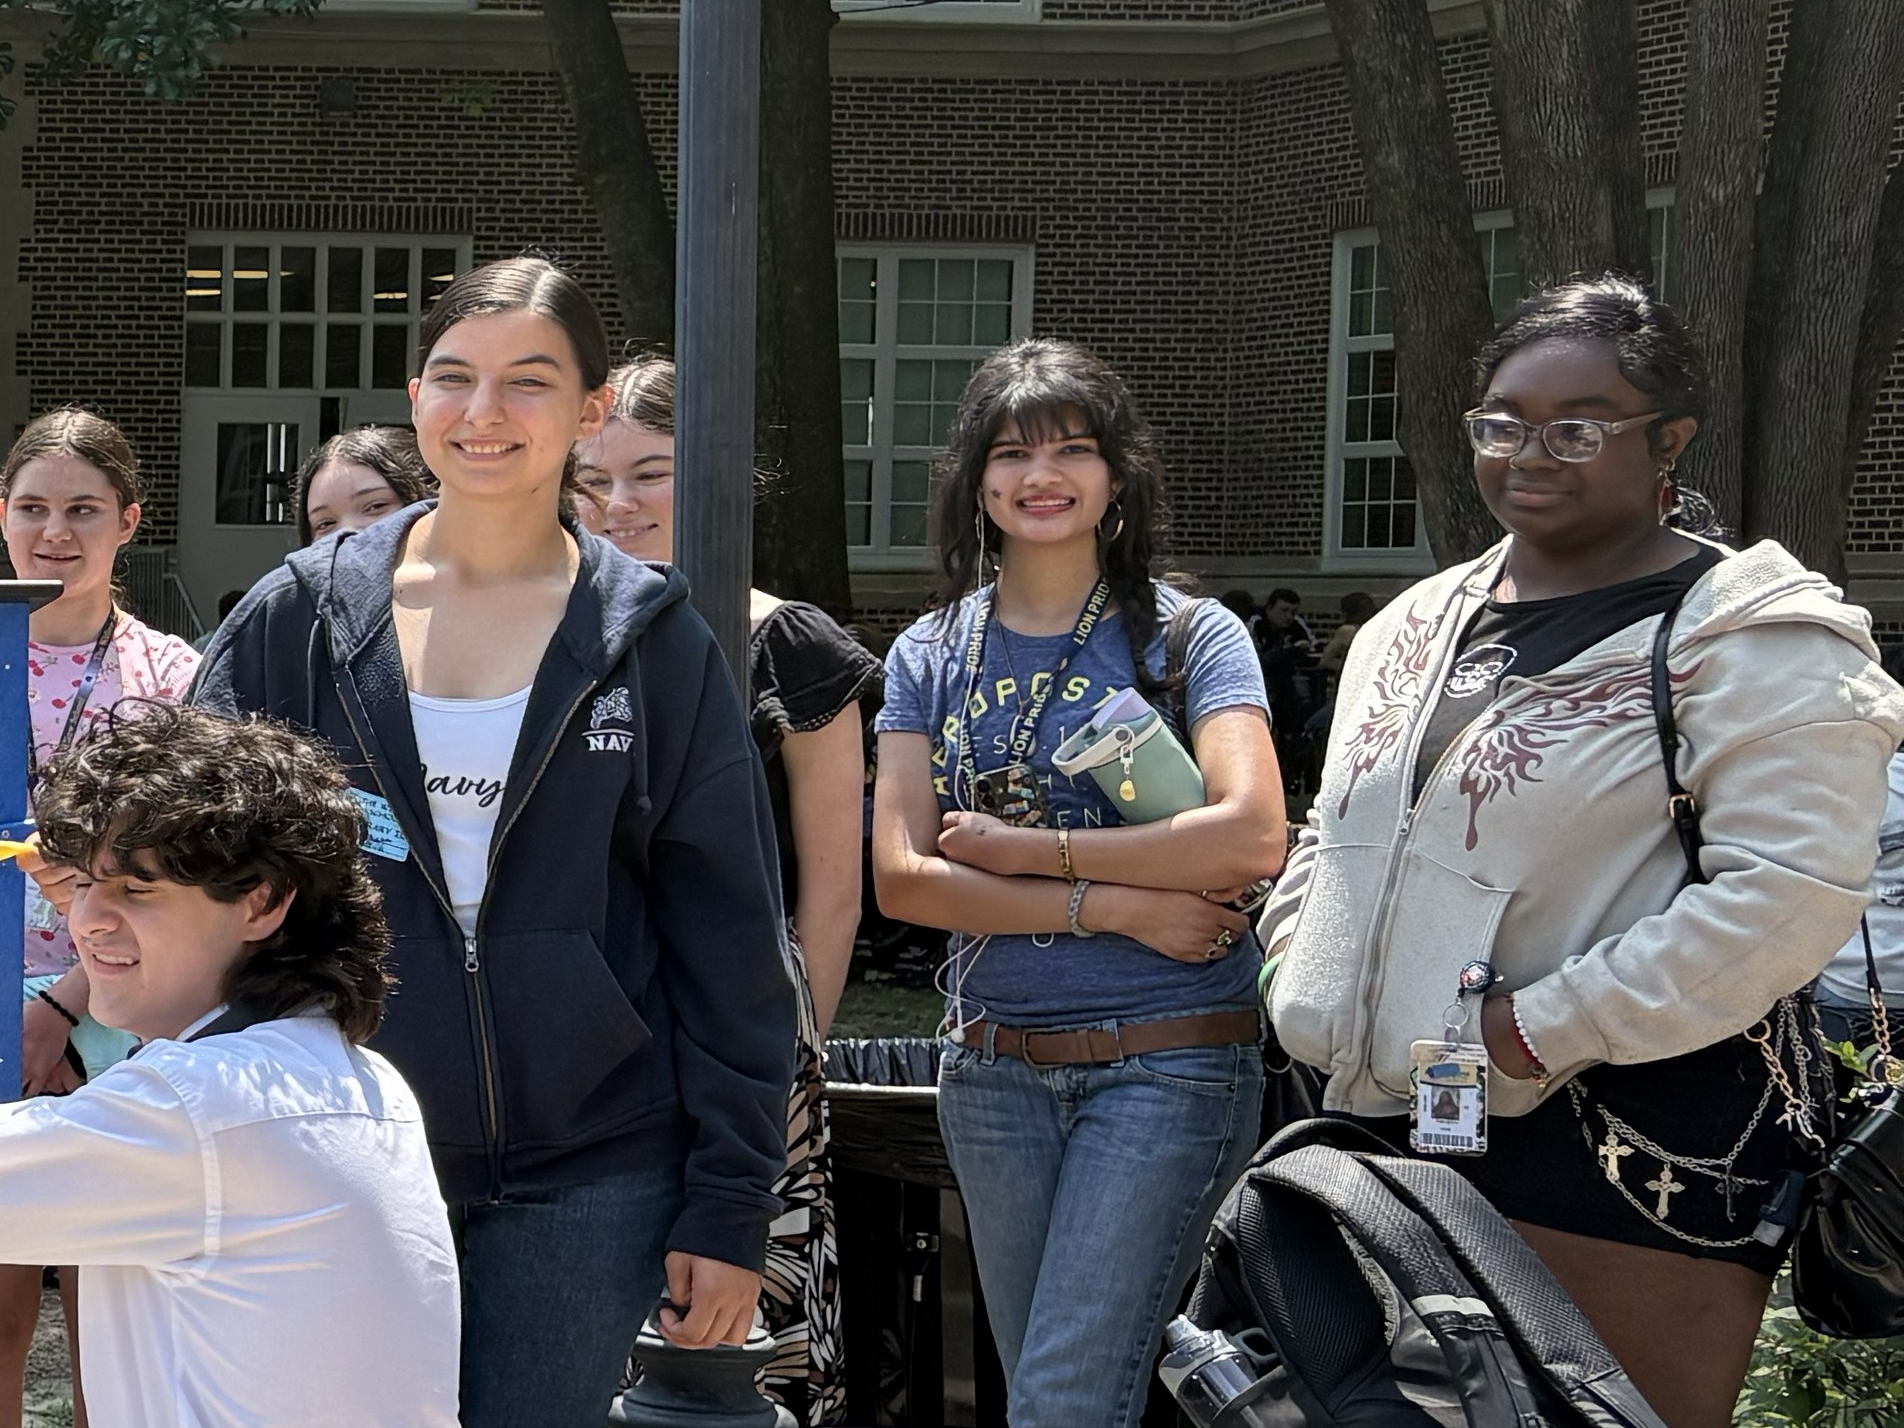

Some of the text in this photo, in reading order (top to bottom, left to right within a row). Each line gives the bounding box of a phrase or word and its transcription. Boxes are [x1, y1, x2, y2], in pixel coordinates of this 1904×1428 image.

[1073, 577, 1110, 646] LION PRID
[586, 735, 634, 752] NAV
[1008, 729, 1032, 766] LION
